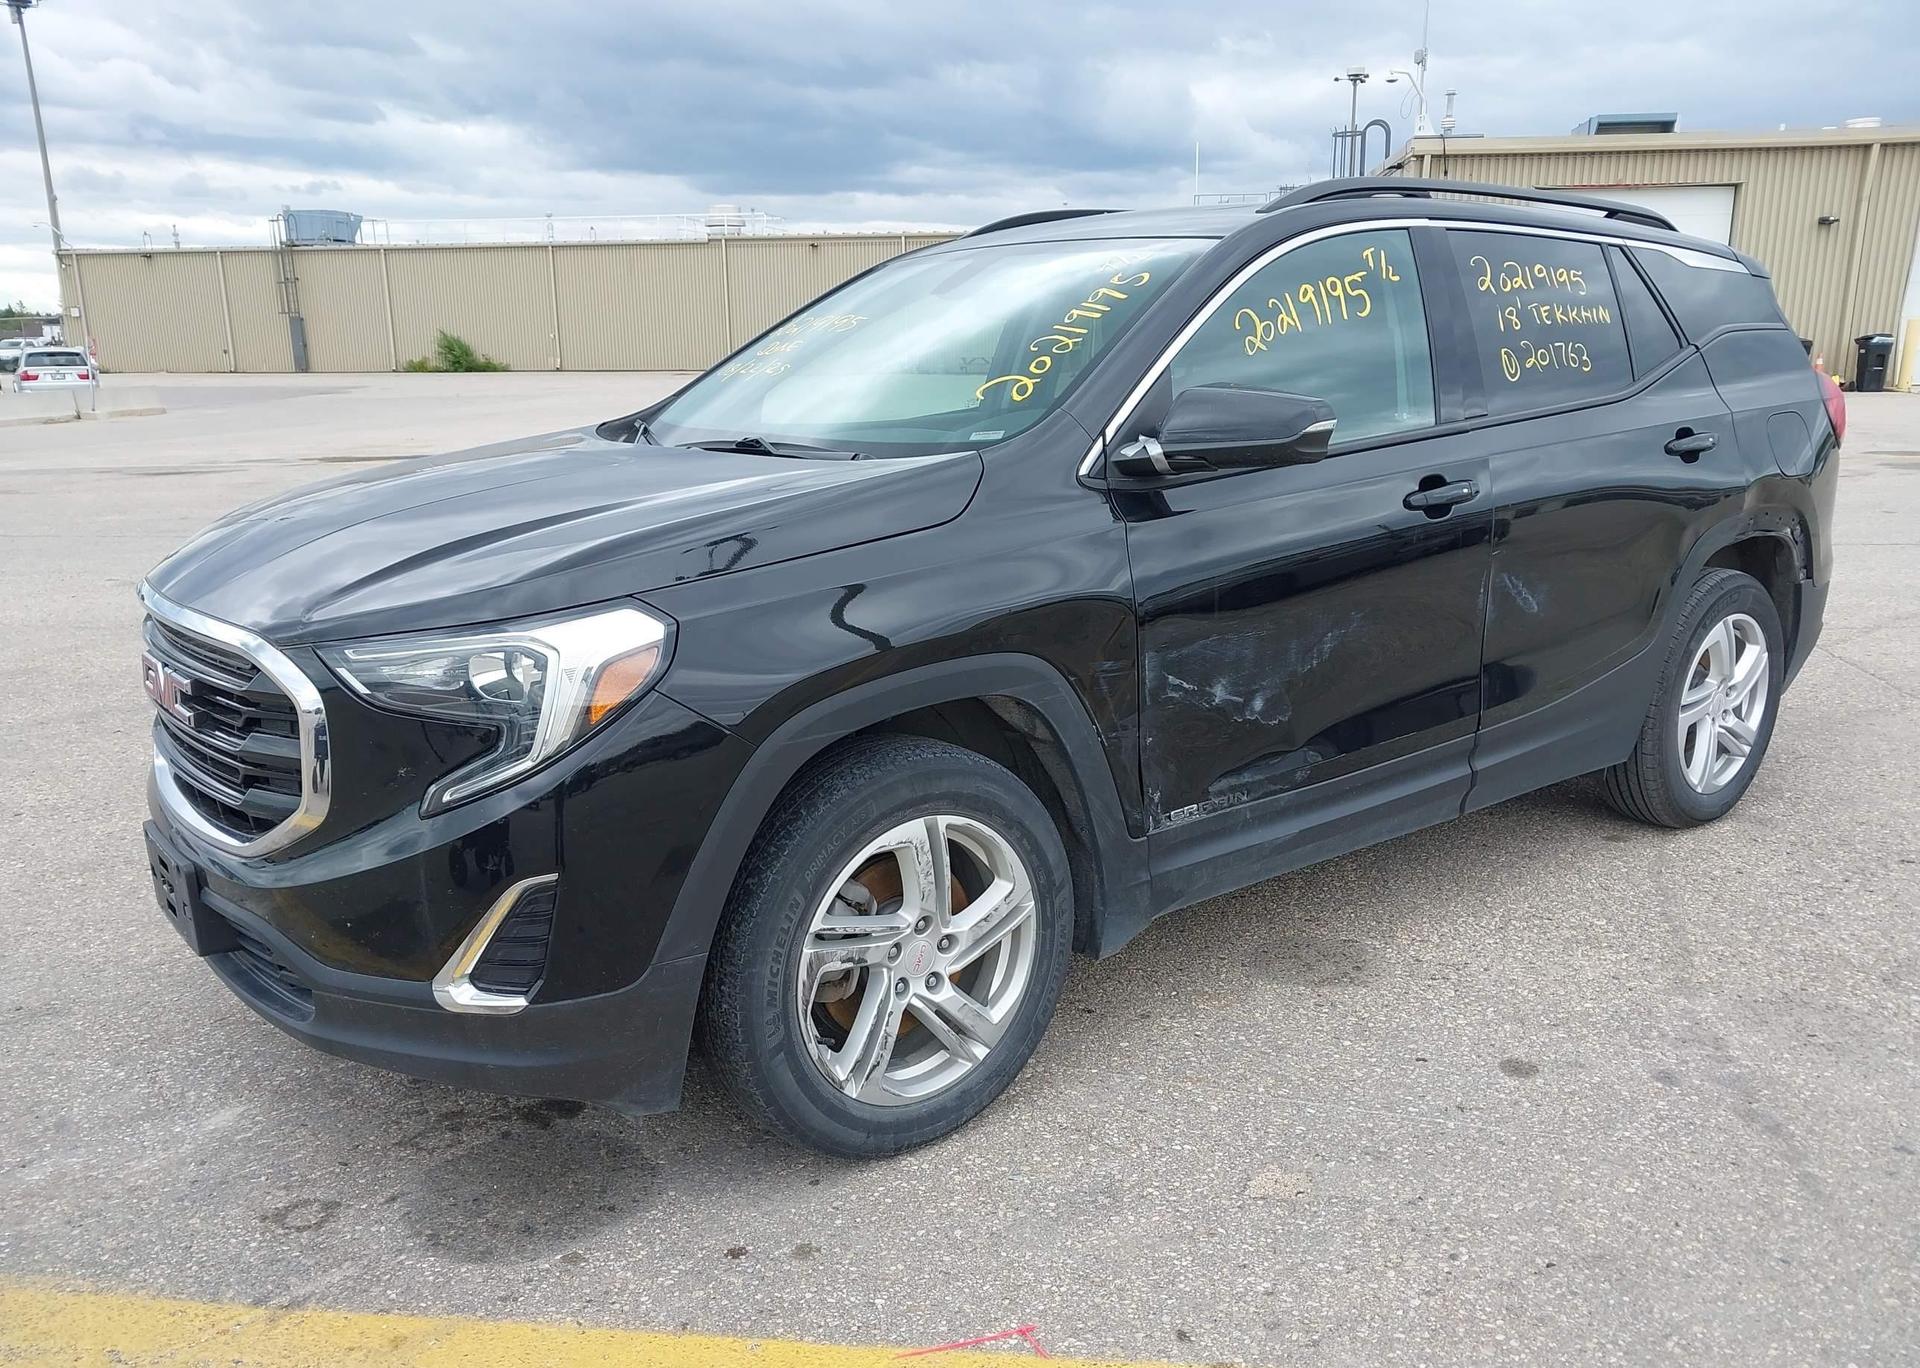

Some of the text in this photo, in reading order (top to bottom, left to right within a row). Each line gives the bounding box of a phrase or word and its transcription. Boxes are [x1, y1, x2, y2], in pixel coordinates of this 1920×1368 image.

[1234, 271, 1372, 357] 20219195
[1470, 256, 1587, 295] 20219195
[976, 270, 1151, 402] 20219195
[1521, 341, 1592, 373] 201763
[142, 650, 195, 728] GMC
[766, 896, 803, 1009] MICHELIN
[912, 943, 929, 973] GMC
